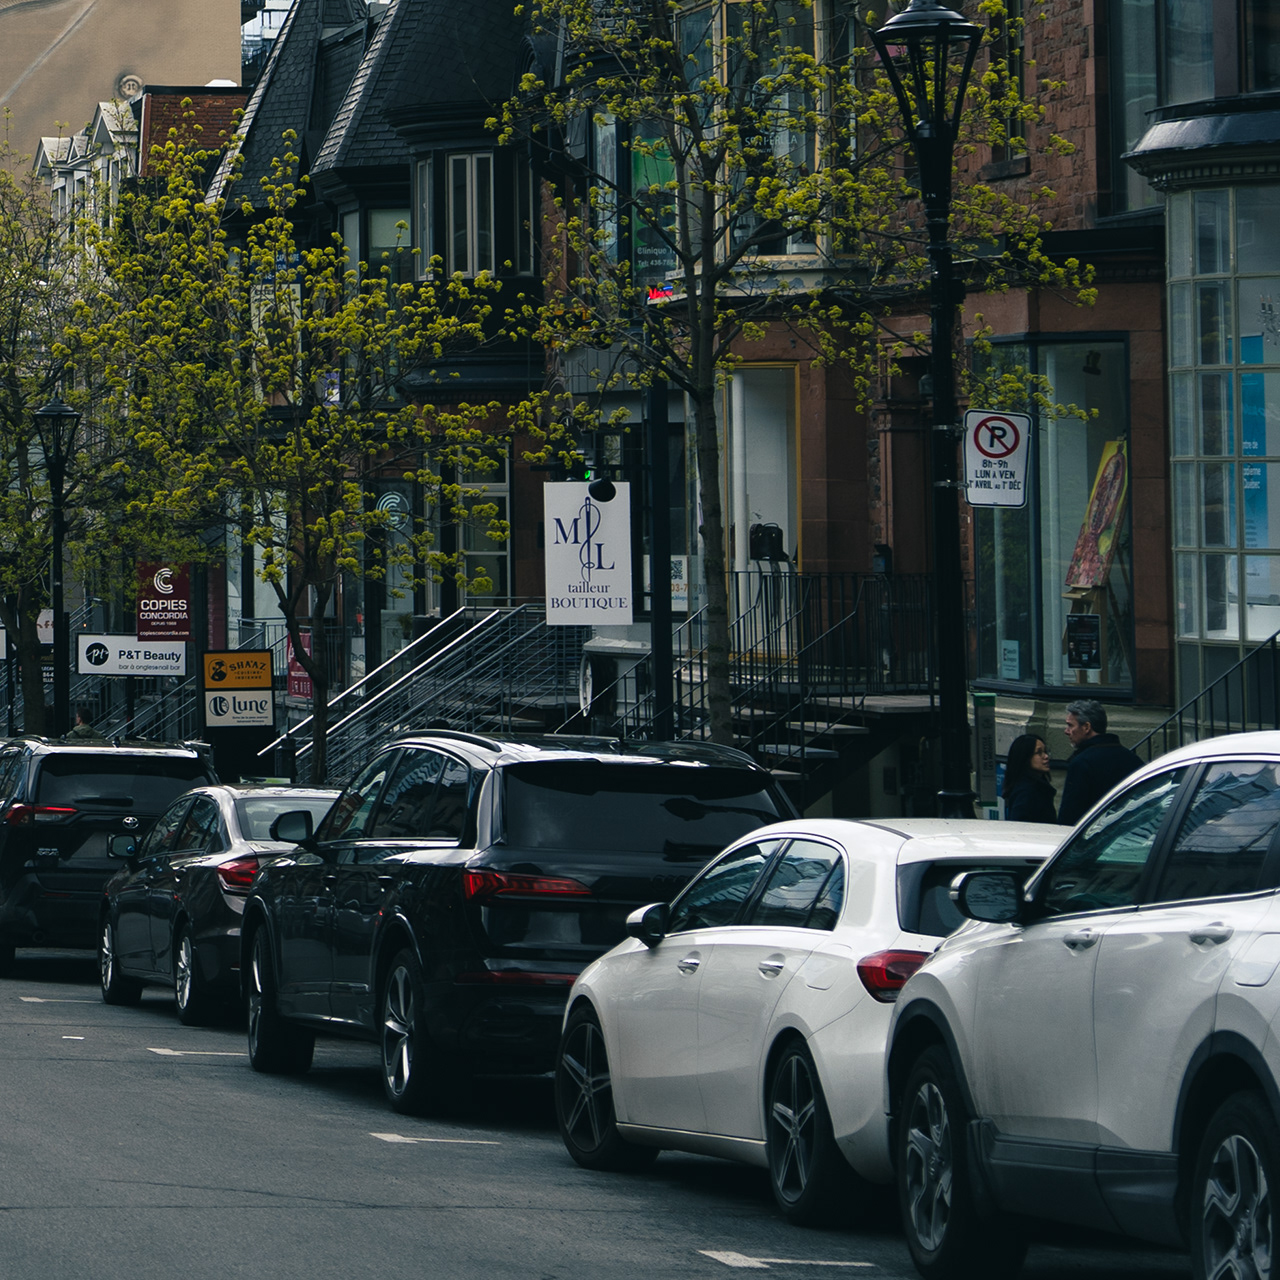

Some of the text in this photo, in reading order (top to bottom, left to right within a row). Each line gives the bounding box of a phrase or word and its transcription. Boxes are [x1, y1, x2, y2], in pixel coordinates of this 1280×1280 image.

[637, 247, 667, 256] Clinique
[975, 470, 991, 479] LUN
[1000, 470, 1016, 479] VEN
[975, 480, 993, 489] AVRIL
[568, 581, 610, 593] tailleur
[140, 600, 187, 610] COPIES
[551, 597, 628, 610] BOUTIQUE
[140, 612, 188, 620] CONCORDIA
[118, 650, 182, 663] P&T Beauty
[229, 660, 267, 672] SHA'AZ
[232, 696, 268, 715] lune
